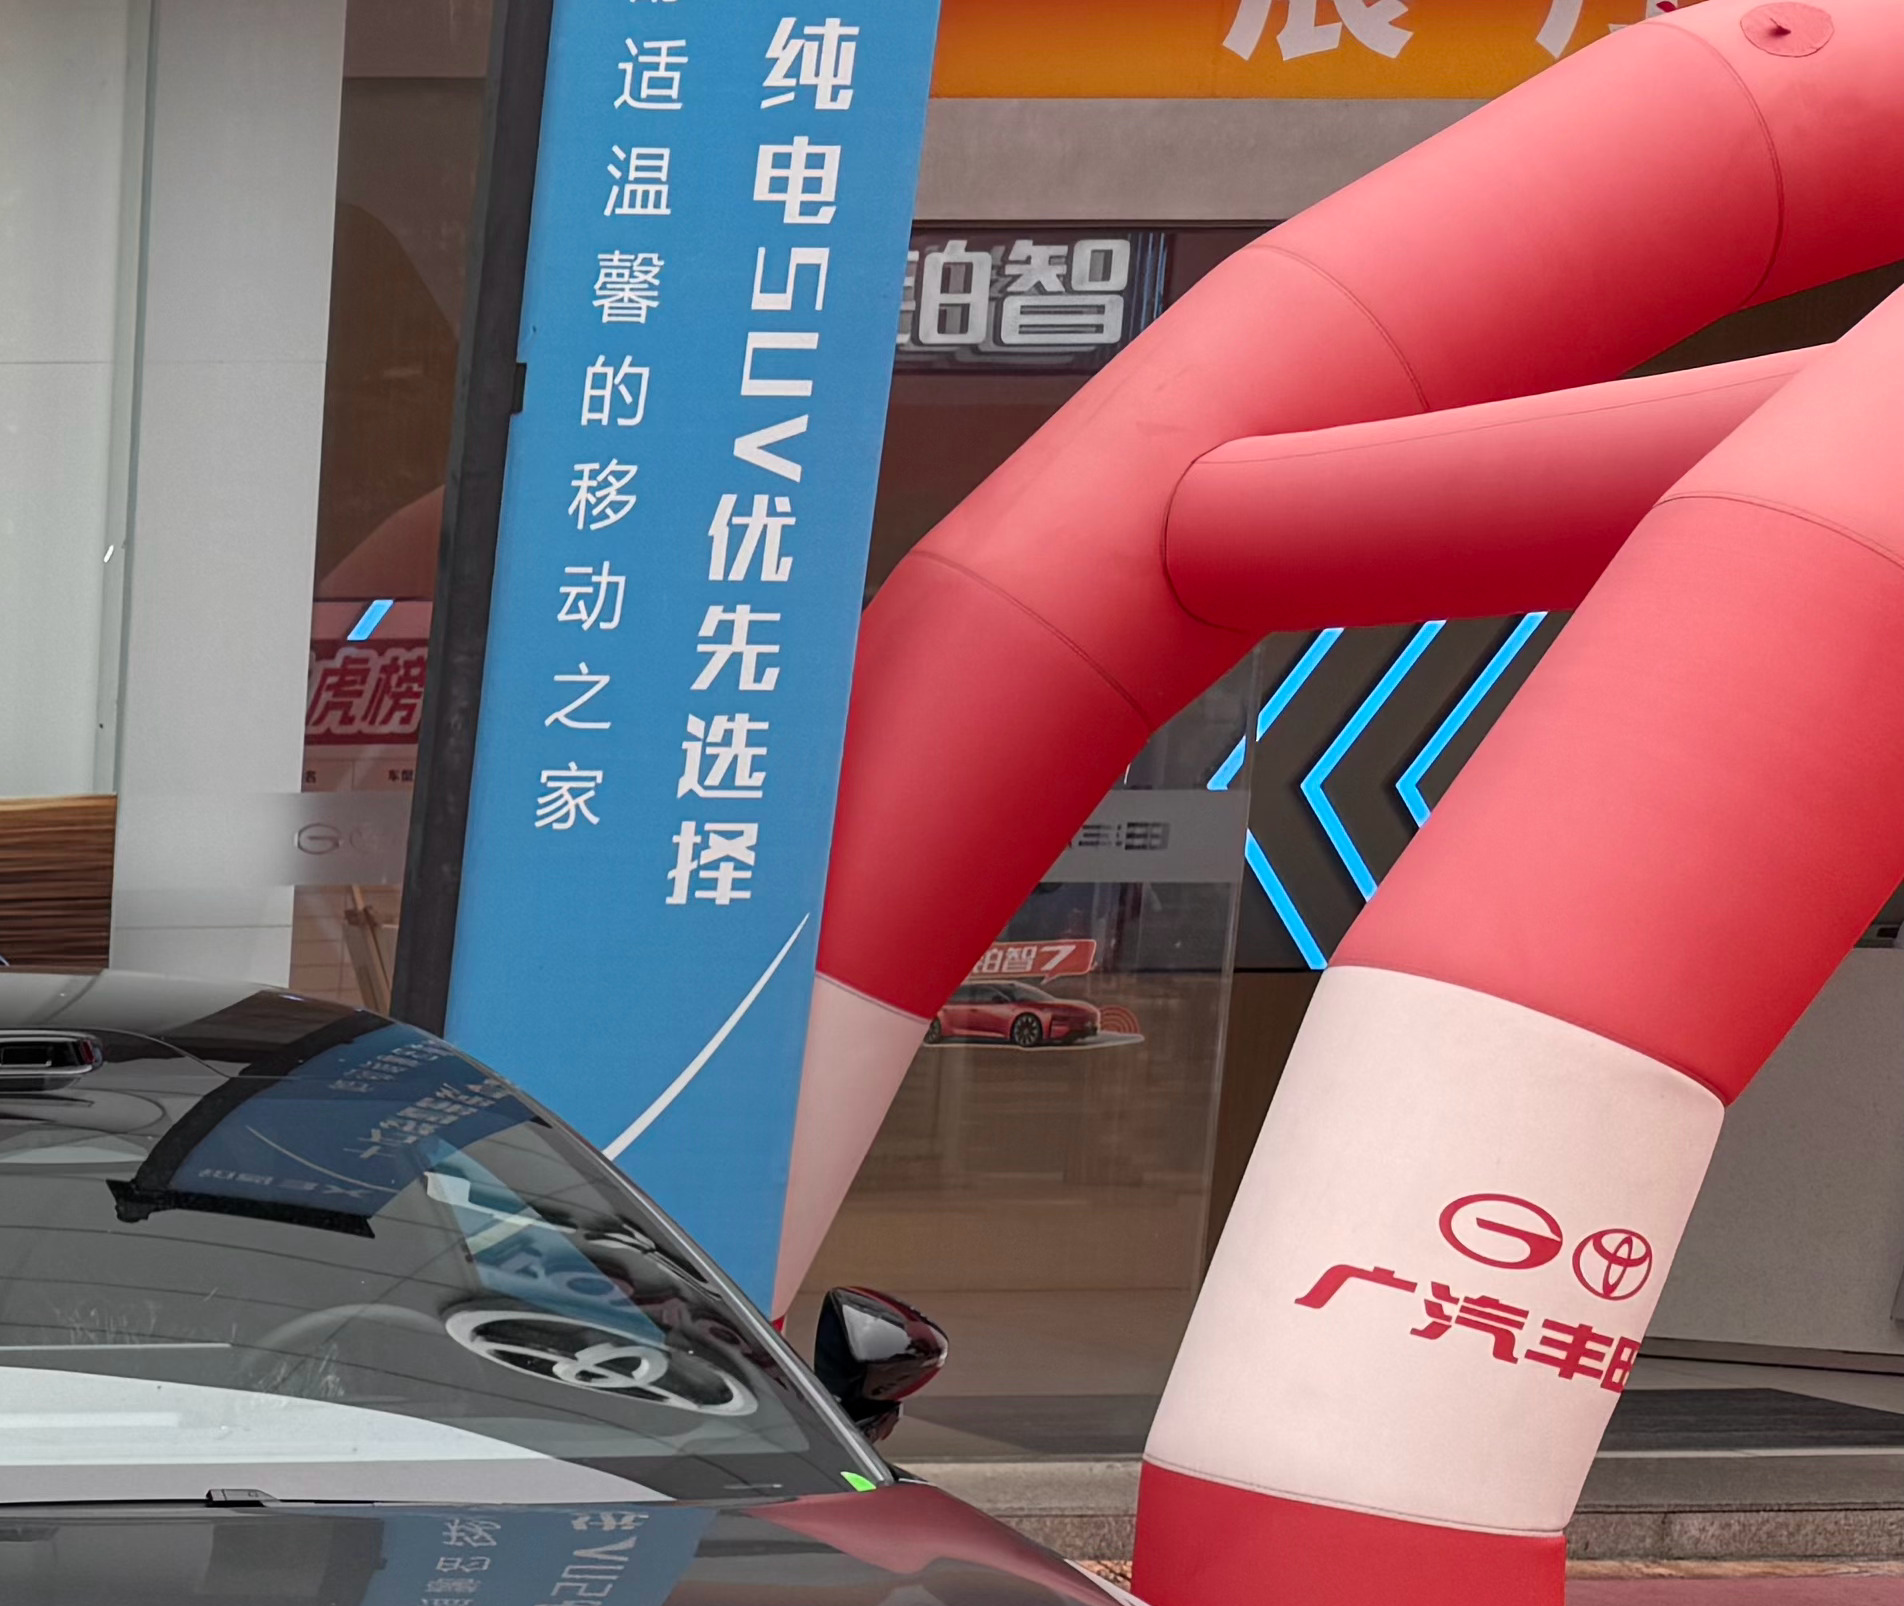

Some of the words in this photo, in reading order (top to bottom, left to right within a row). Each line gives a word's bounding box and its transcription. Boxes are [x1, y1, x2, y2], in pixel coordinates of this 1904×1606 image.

[534, 0, 689, 830] 适温馨的移动之家
[665, 17, 860, 907] 纯电SUV优先选择
